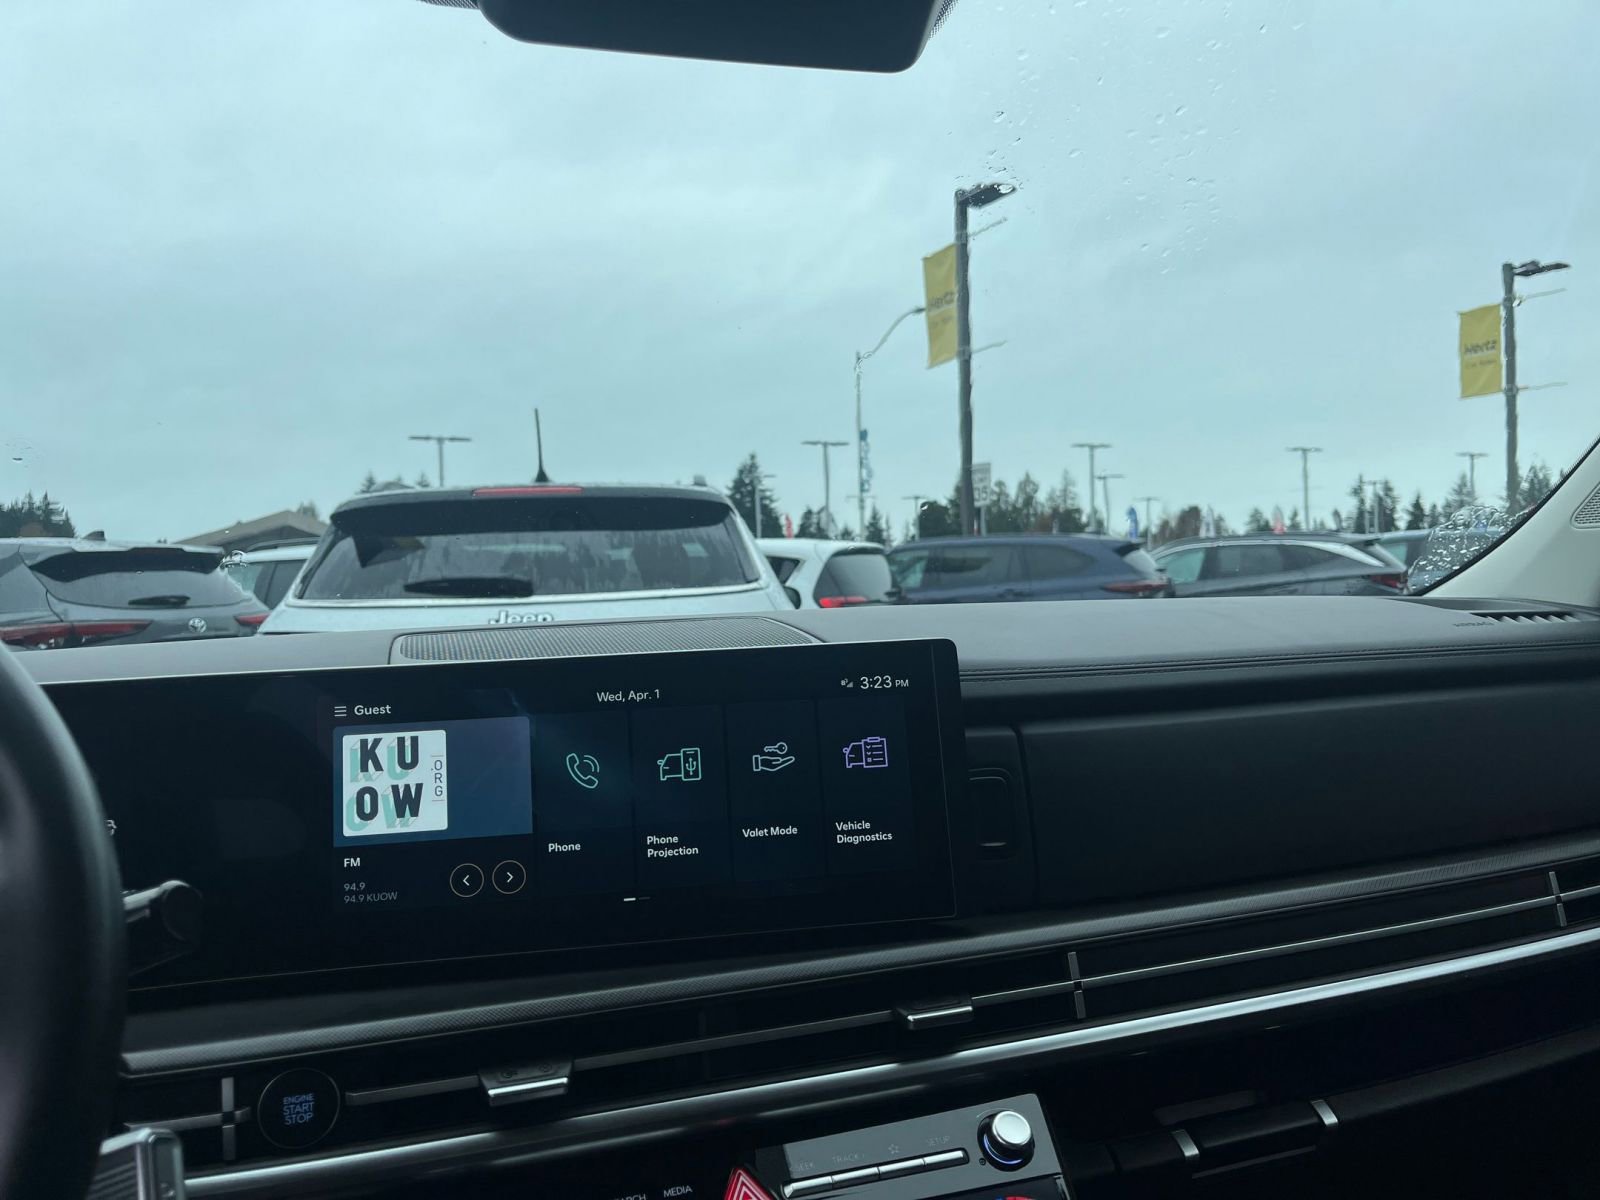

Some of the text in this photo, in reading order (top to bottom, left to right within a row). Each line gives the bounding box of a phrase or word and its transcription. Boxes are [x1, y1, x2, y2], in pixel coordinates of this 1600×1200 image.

[860, 675, 909, 689] 3:23 PM
[596, 689, 660, 702] Wed, Apr. 1
[353, 704, 392, 716] Guest
[742, 825, 798, 838] Valet Mode
[835, 820, 871, 831] Vehicle
[646, 835, 679, 846] Phone
[836, 831, 893, 844] Diagnostics
[548, 842, 581, 852] Phone
[647, 845, 699, 858] Projection
[343, 857, 361, 868] FM
[343, 881, 366, 892] 94.9
[343, 891, 398, 904] 94.9 KUOW
[283, 1093, 315, 1104] ENGINE
[283, 1102, 314, 1115] START
[284, 1112, 313, 1125] STOP
[663, 1185, 693, 1198] MEDIA
